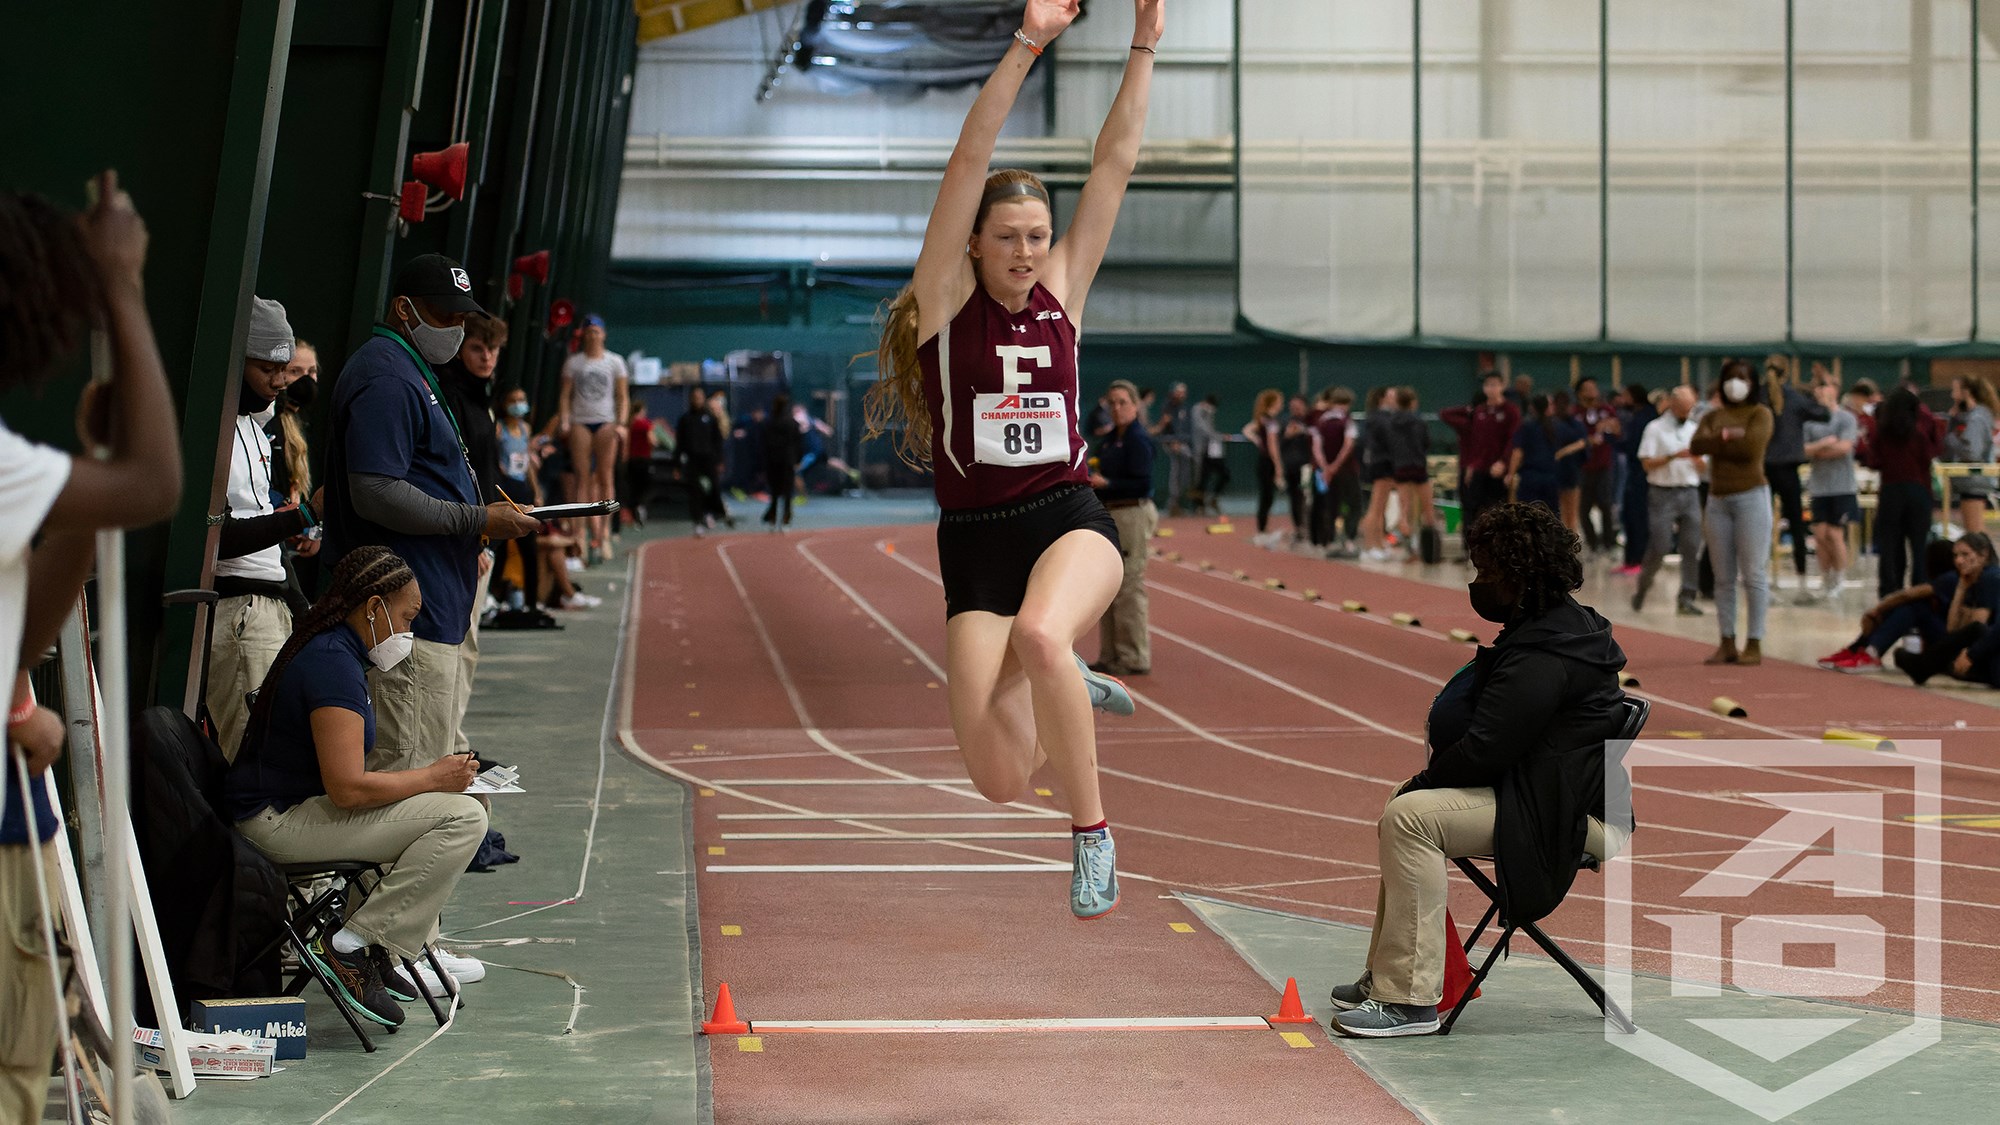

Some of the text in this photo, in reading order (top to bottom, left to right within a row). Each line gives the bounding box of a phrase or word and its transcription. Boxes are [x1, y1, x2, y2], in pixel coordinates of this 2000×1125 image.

[996, 345, 1052, 394] F
[994, 395, 1050, 409] A10
[981, 411, 1062, 420] CHAMPIONSHIPS
[1004, 423, 1043, 455] 89
[1009, 491, 1062, 517] ARMOUR
